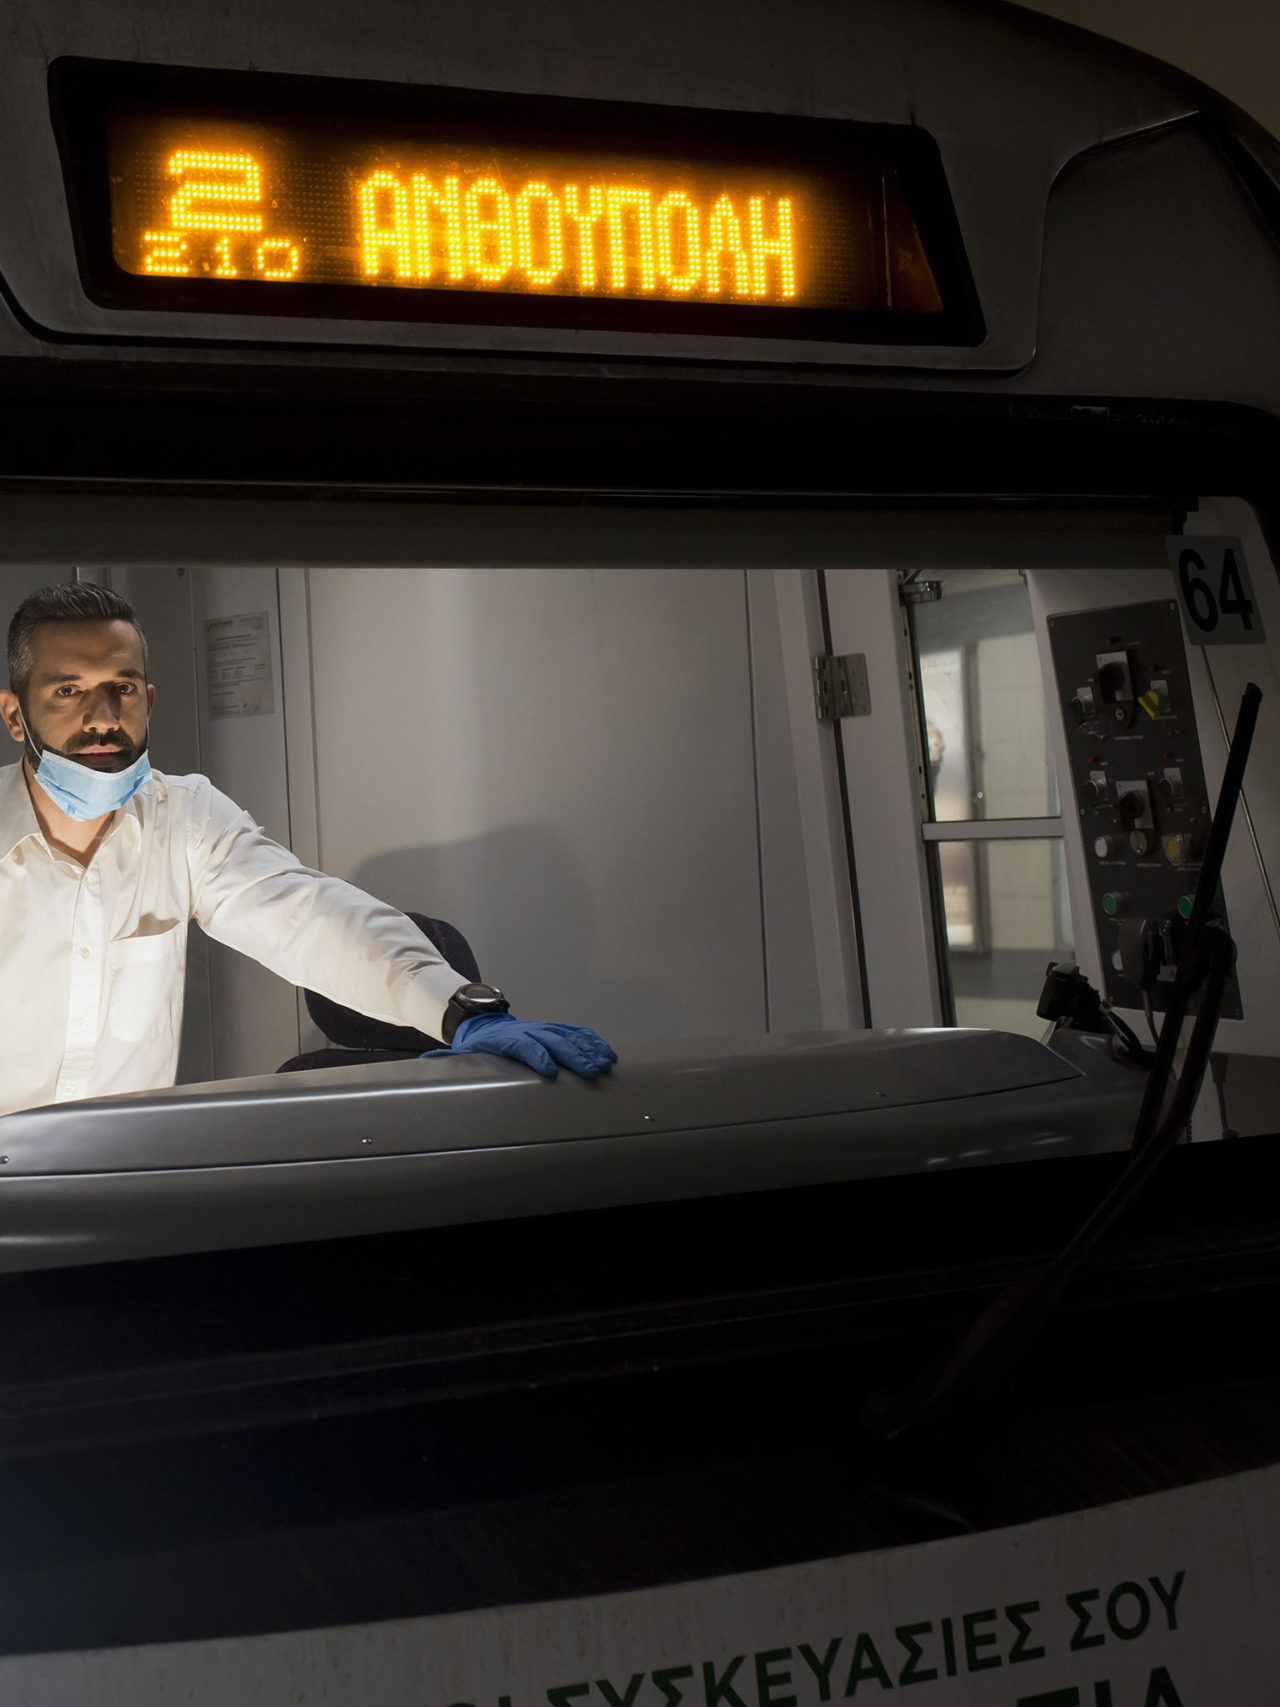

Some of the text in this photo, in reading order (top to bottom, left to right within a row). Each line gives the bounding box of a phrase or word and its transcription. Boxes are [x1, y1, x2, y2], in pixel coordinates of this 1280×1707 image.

[169, 151, 795, 297] 2 ΑΝΘΟΥΠΟΛΗ
[1177, 548, 1255, 632] 64
[1064, 1571, 1187, 1651] ΣΟΥ
